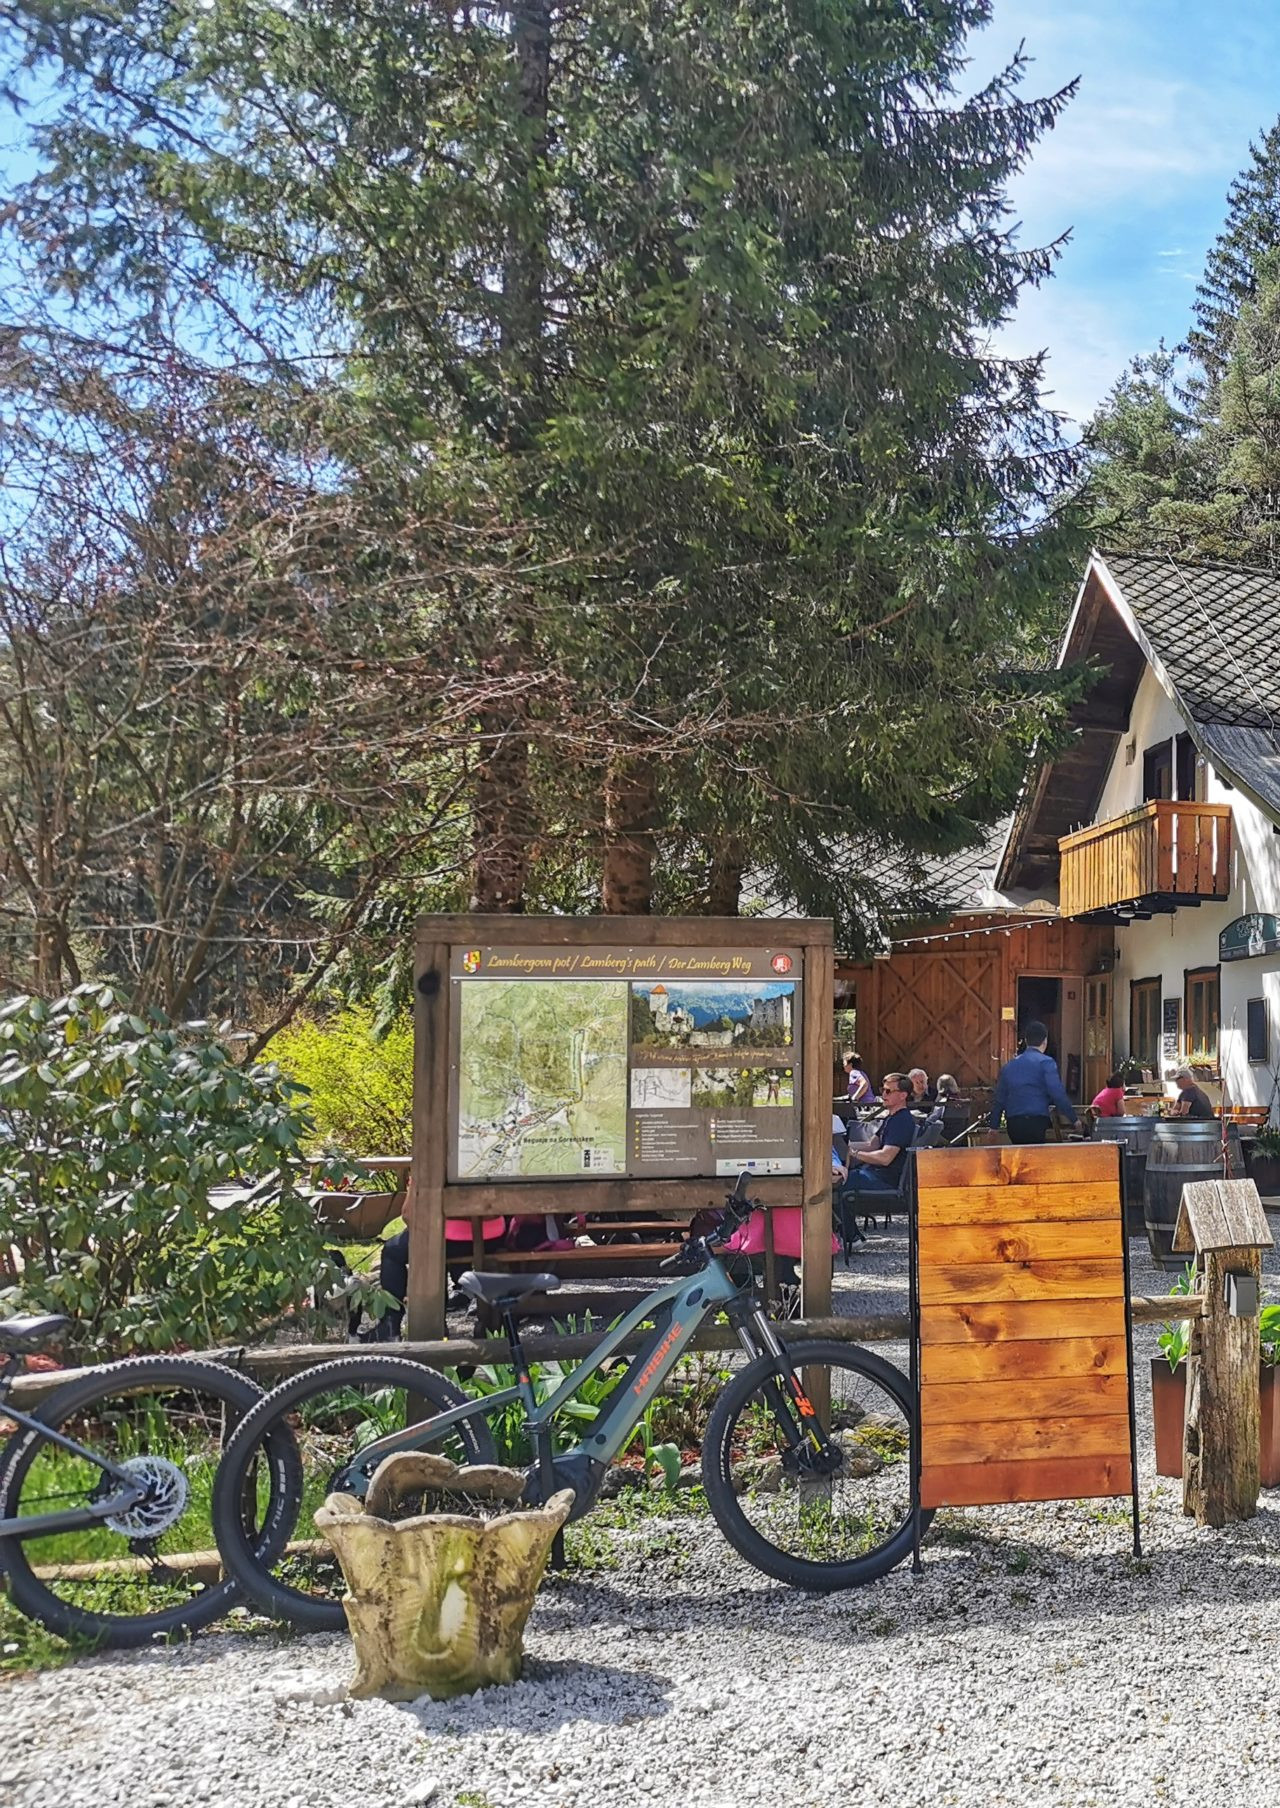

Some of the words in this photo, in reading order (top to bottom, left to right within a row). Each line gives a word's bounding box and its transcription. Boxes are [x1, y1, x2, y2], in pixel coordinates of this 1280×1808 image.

[488, 953, 552, 973] Lambergova
[552, 956, 571, 973] pot
[580, 953, 633, 973] Lamberg's
[632, 954, 656, 972] path
[668, 957, 686, 970] Der
[686, 956, 731, 975] Lamberg
[731, 957, 752, 975] Weg
[634, 1321, 683, 1396] HAIBIKE
